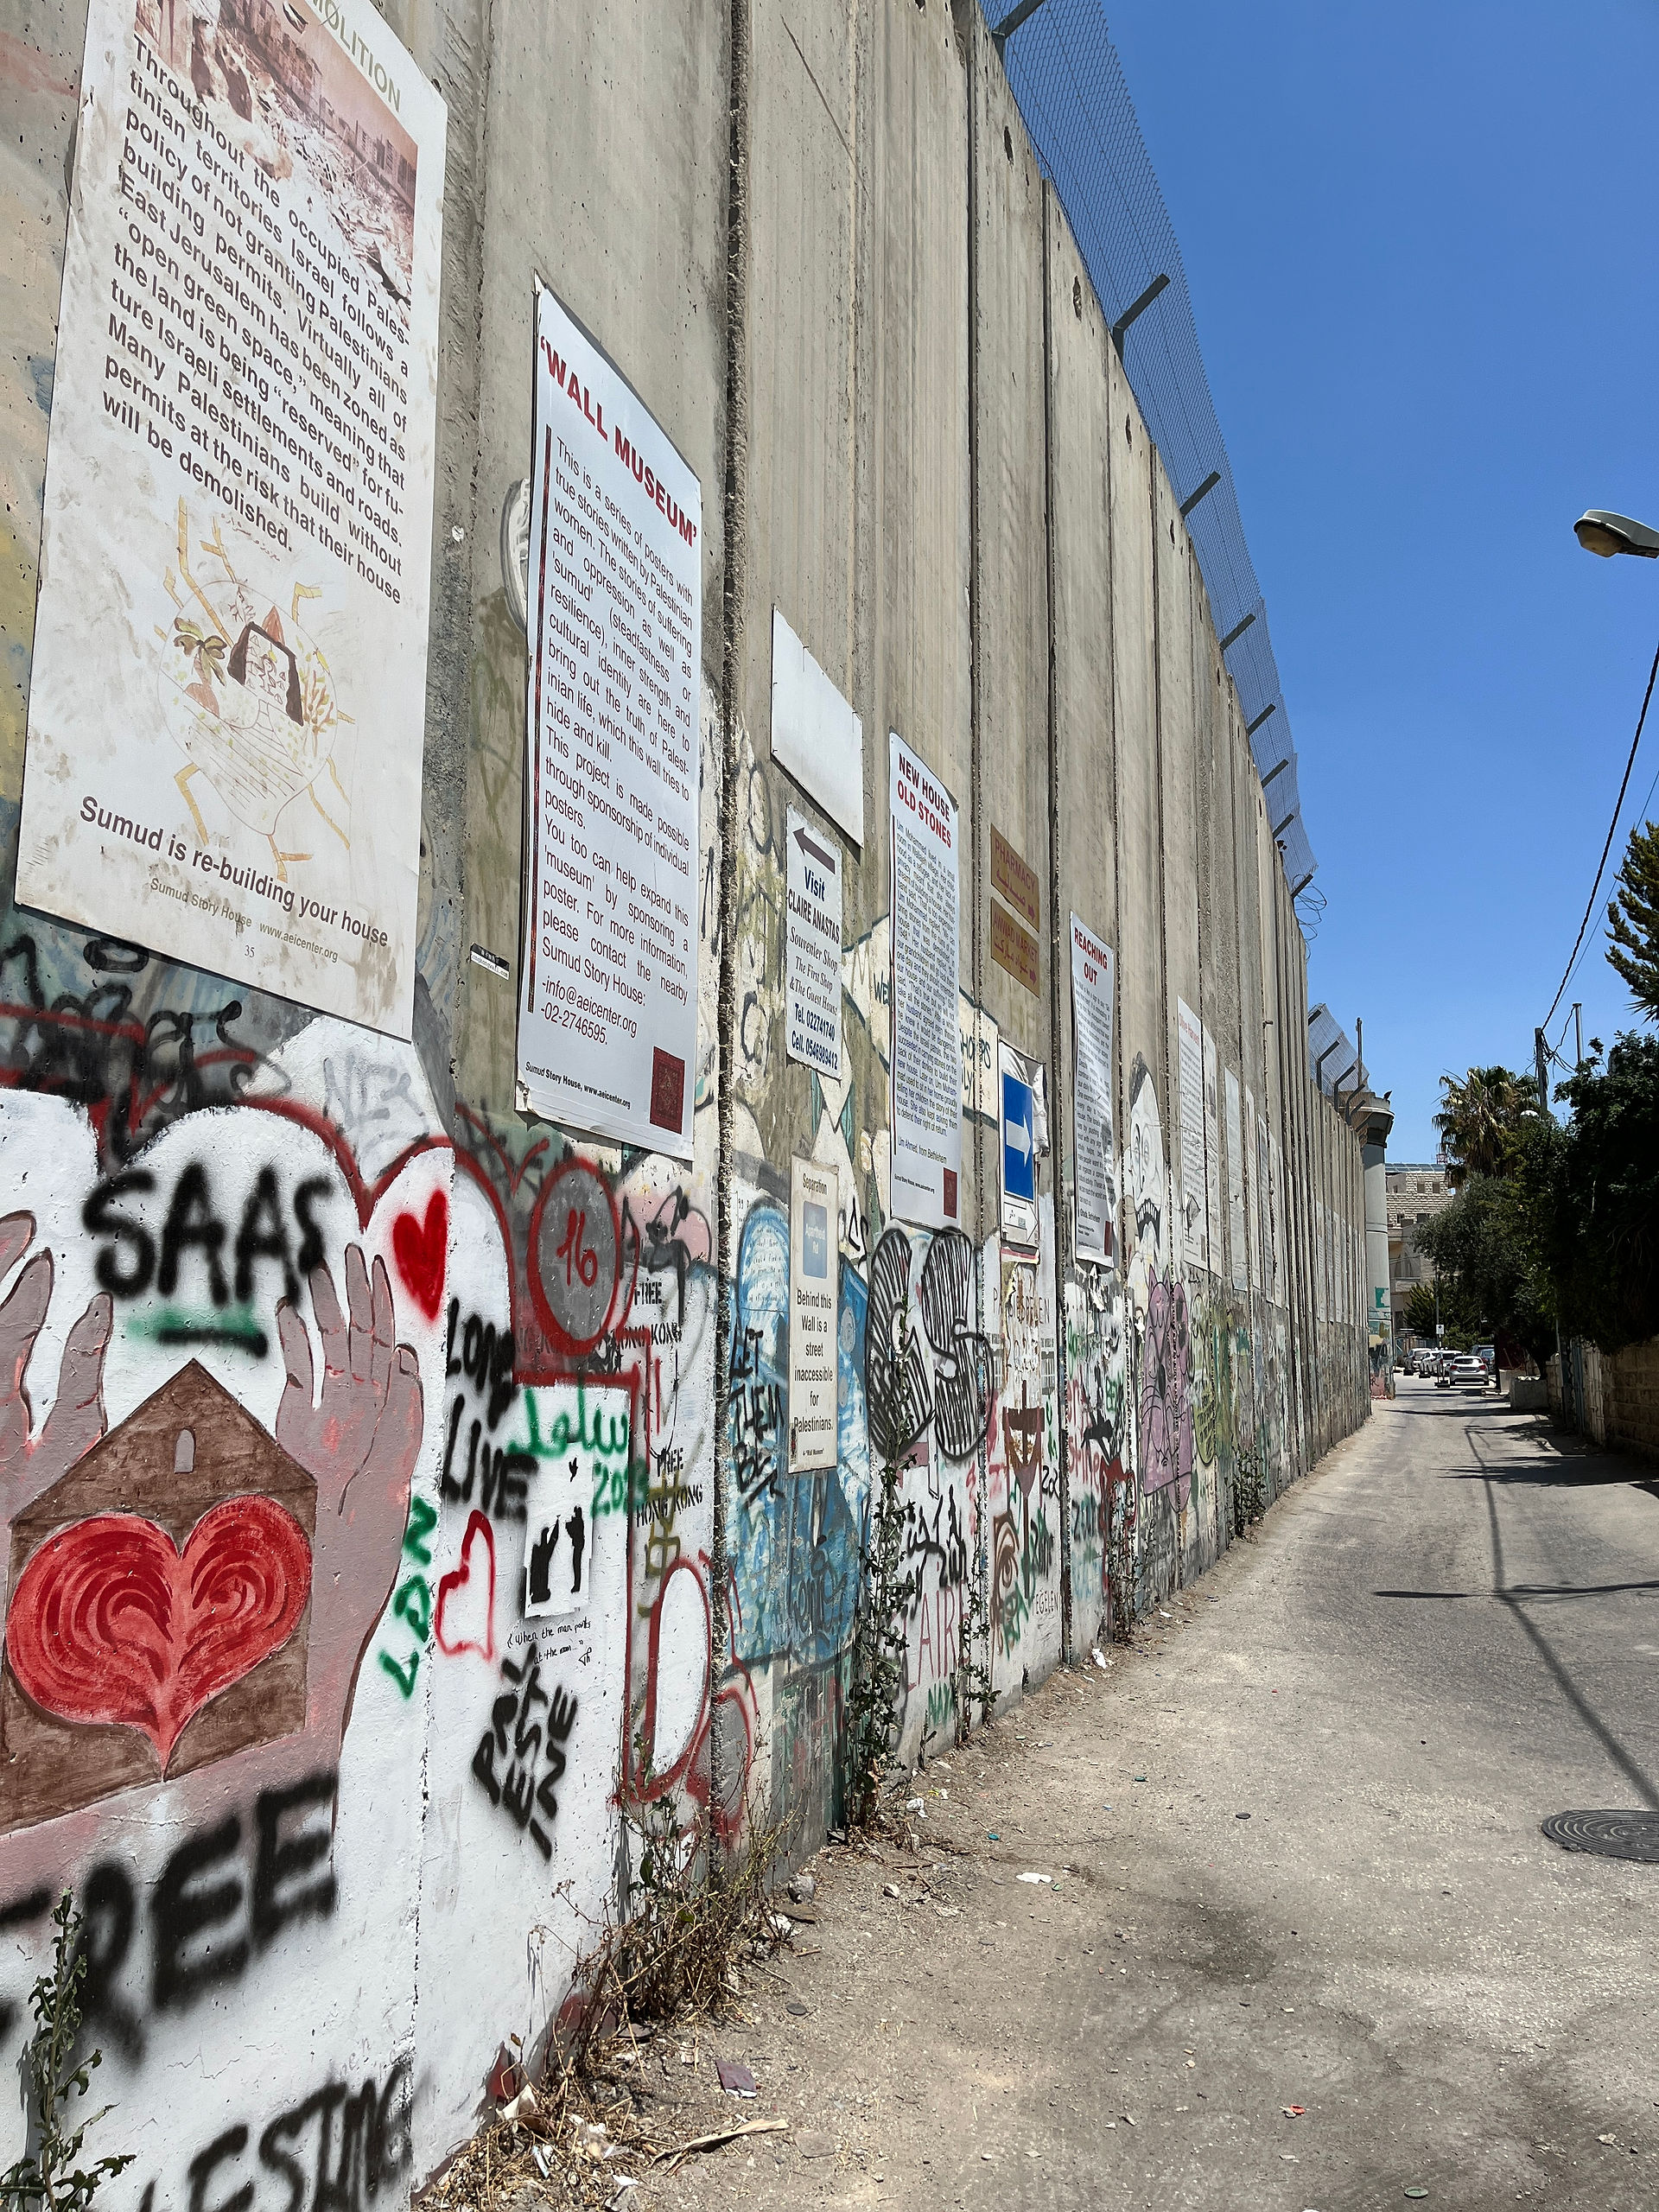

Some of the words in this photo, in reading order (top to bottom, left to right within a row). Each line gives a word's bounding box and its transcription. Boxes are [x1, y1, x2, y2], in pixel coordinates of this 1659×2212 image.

[133, 33, 245, 172] Throughout
[253, 166, 280, 207] the
[289, 209, 359, 296] occupied
[367, 289, 410, 346] Pales-
[130, 69, 185, 143] tinian
[195, 138, 282, 243] territories
[291, 238, 334, 299] Israel
[341, 293, 393, 361] follows
[400, 360, 408, 378] a
[123, 136, 205, 237] building
[215, 232, 286, 315] permits.
[296, 307, 361, 390] Virtually
[368, 386, 385, 412] all
[393, 410, 406, 433] of
[125, 107, 188, 181] policy
[191, 175, 211, 202] of
[213, 194, 243, 237] not
[245, 230, 315, 315] granting
[319, 299, 407, 405] Palestinians
[120, 167, 166, 232] East
[169, 222, 265, 327] Jerusalem
[269, 314, 299, 359] has
[302, 346, 340, 399] been
[343, 391, 387, 445] zoned
[389, 436, 405, 461] as
[118, 207, 179, 281] “open
[183, 274, 237, 334] green
[241, 327, 306, 394] space,”
[309, 391, 374, 467] meaning
[378, 451, 404, 491] that
[103, 391, 139, 434] will
[147, 420, 173, 458] be
[179, 451, 292, 552] demolished.
[556, 435, 579, 476] This
[582, 466, 591, 489] is
[594, 485, 601, 501] a
[604, 495, 632, 536] series
[633, 531, 642, 548] of
[645, 543, 674, 586] posters
[676, 580, 692, 607] with
[556, 467, 575, 500] true
[577, 493, 609, 537] stories
[610, 529, 639, 570] written
[639, 558, 650, 586] by
[650, 571, 692, 631] Palestinian
[897, 779, 916, 811] OLD
[918, 800, 951, 849] STONES
[899, 752, 920, 789] NEW
[921, 777, 950, 823] HOUSE
[79, 796, 163, 851] Sumud
[168, 833, 187, 861] is
[192, 849, 295, 912] re-building
[298, 896, 338, 925] your
[340, 910, 388, 947] house
[804, 866, 825, 902] Visit
[995, 837, 1035, 894] PHARMACY
[150, 874, 189, 902] Sumud
[220, 903, 252, 926] House
[259, 919, 338, 962] www.aeicenter.org
[787, 888, 811, 924] CLAIRE
[811, 907, 840, 944] ANASTAS
[542, 936, 581, 973] Sumud
[583, 958, 610, 992] Story
[613, 973, 645, 1007] House:
[543, 909, 579, 942] please
[590, 937, 626, 969] contact
[637, 959, 651, 982] the
[660, 976, 688, 1006] nearby
[790, 925, 823, 961] Souvenier
[822, 949, 838, 976] Shop
[795, 955, 806, 974] The
[806, 963, 820, 983] First
[819, 972, 833, 995] Shop
[1016, 930, 1038, 964] MARKET
[1074, 926, 1108, 970] REACHING
[1084, 962, 1097, 986] OUT
[540, 1001, 607, 1045] -02-2746595.
[542, 975, 637, 1039] -info@aeicenter.org
[789, 976, 805, 996] &The
[806, 986, 822, 1006] Guest
[822, 995, 837, 1016] House
[794, 1002, 805, 1025] Tel.
[791, 1030, 804, 1053] Cell.
[802, 1173, 827, 1195] Separation
[81, 1162, 334, 1307] SAAS
[796, 1287, 820, 1307] Behind
[820, 1294, 831, 1309] this
[801, 1314, 816, 1332] Wall
[817, 1316, 823, 1332] is
[823, 1320, 828, 1332] a
[794, 1365, 833, 1382] inaccessible
[805, 1341, 823, 1357] street
[793, 1415, 833, 1434] Palestinians.
[810, 1389, 819, 1407] for
[440, 1394, 539, 1521] LIVE
